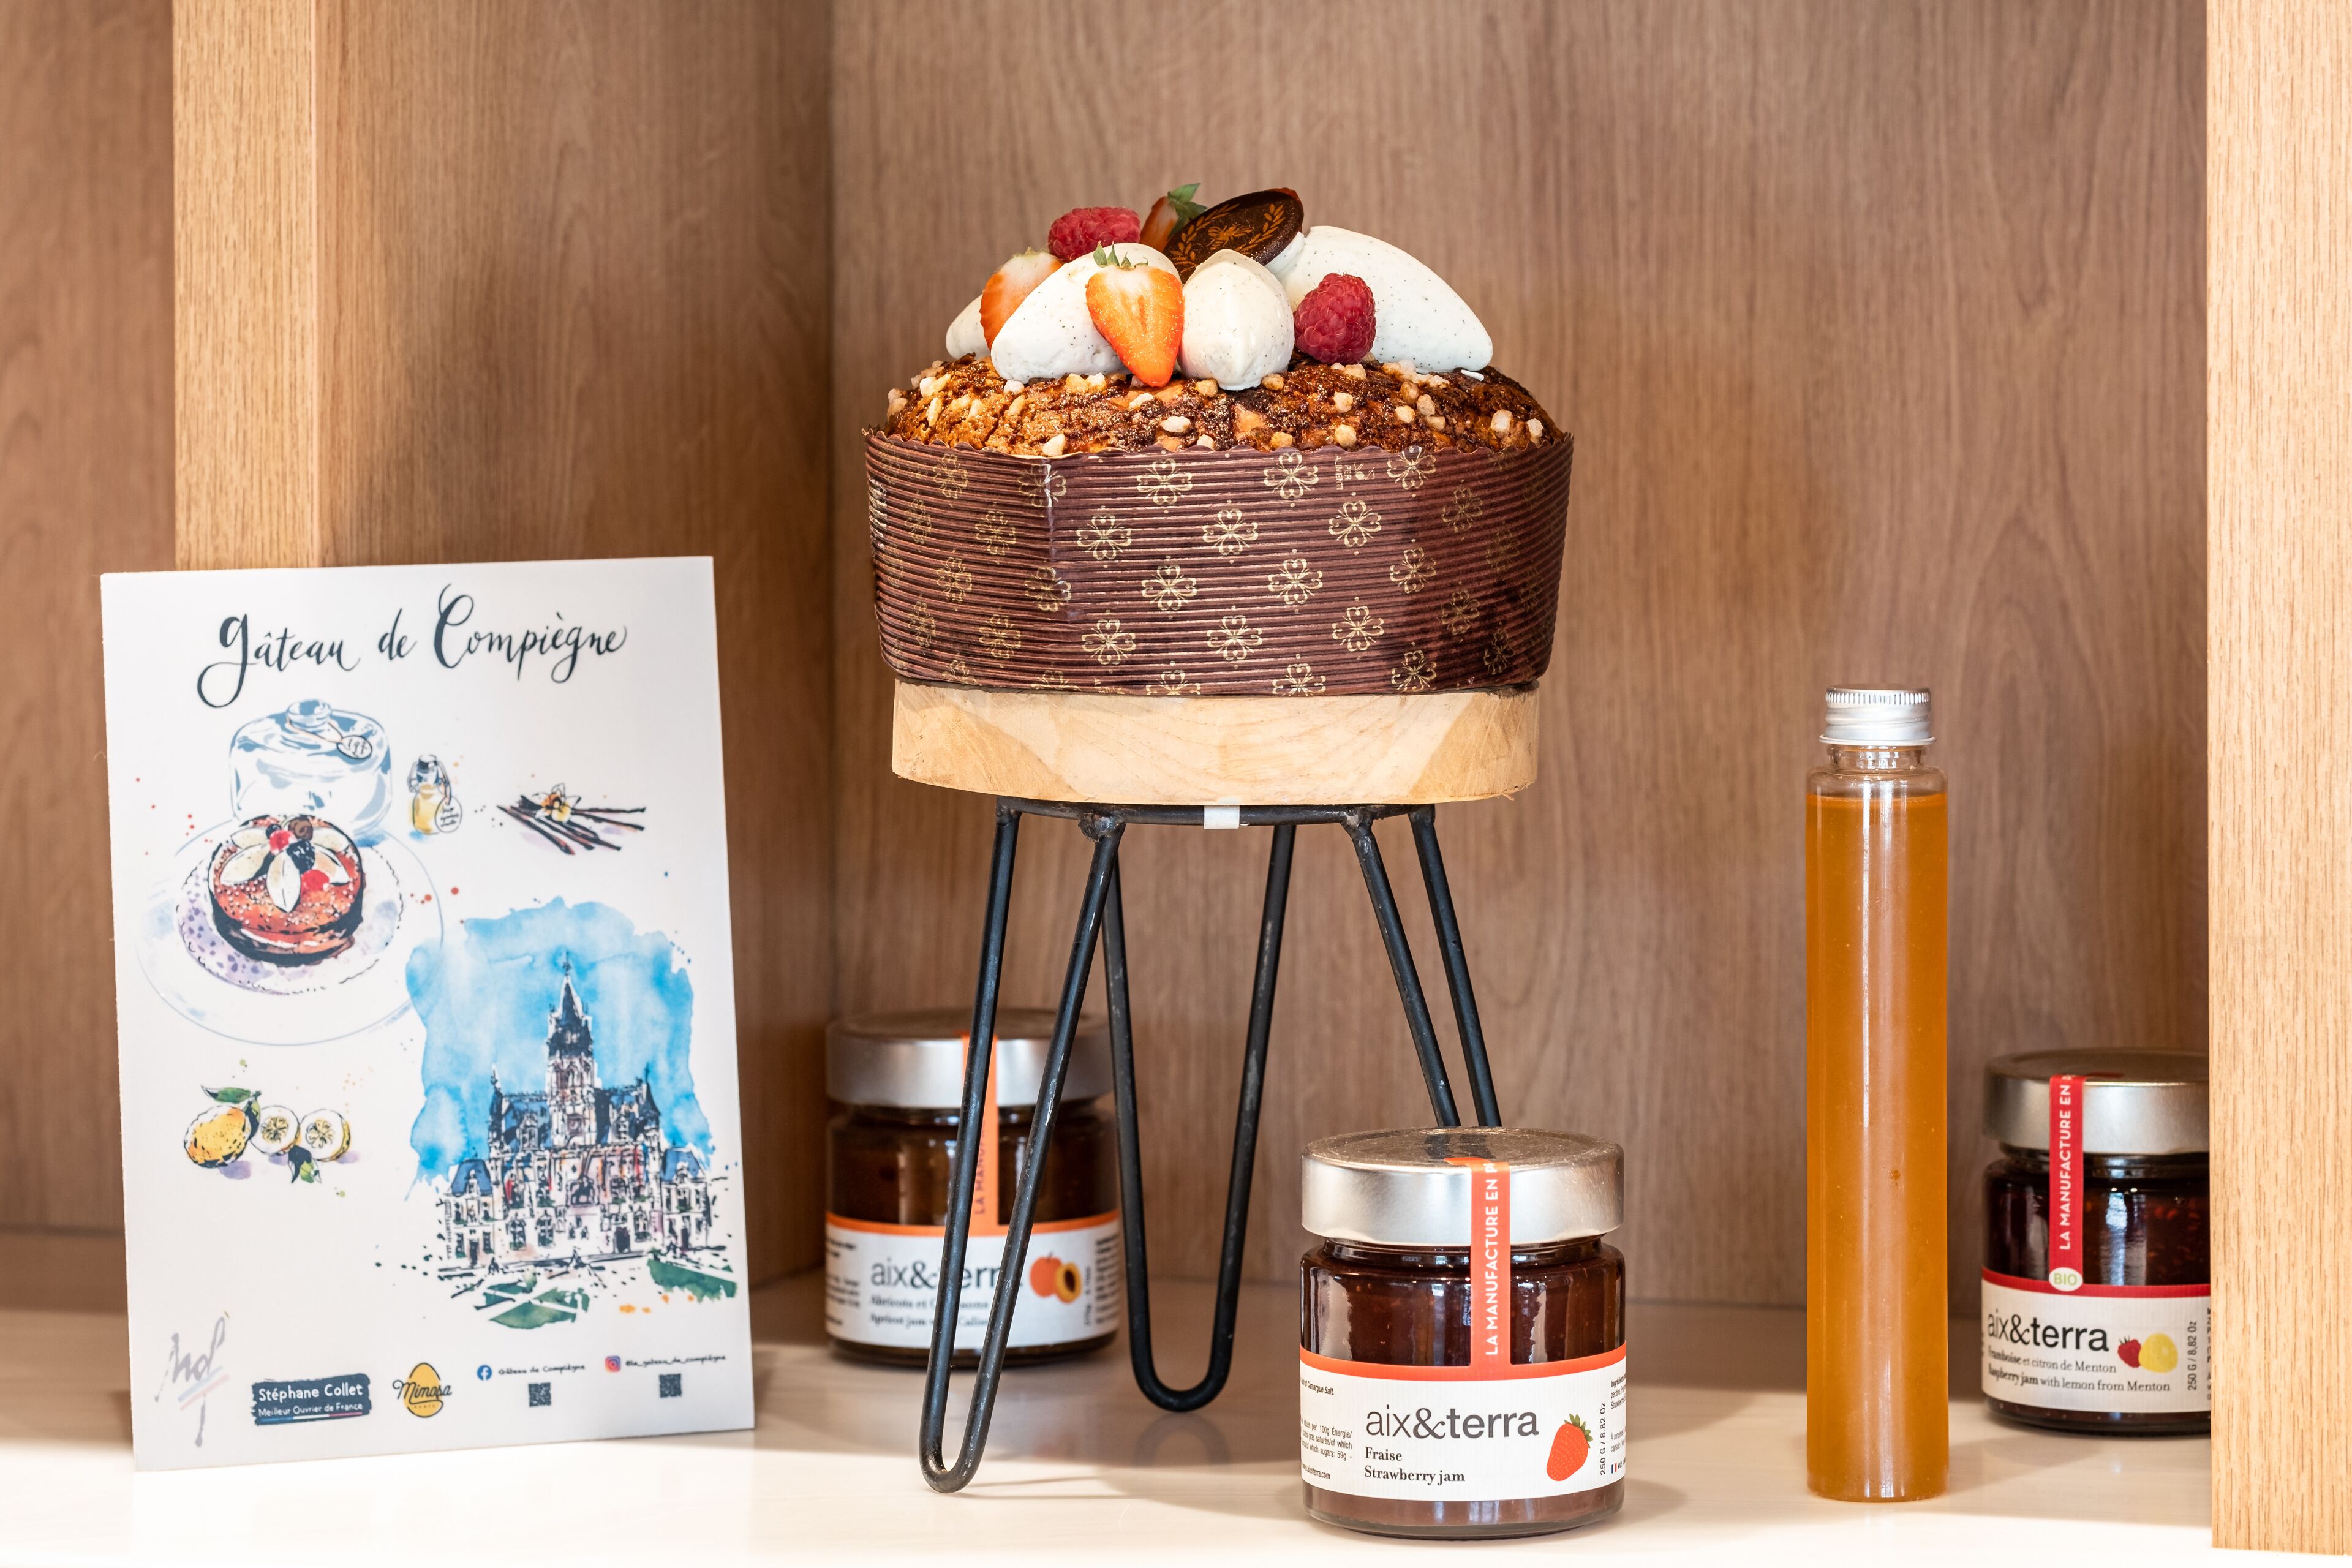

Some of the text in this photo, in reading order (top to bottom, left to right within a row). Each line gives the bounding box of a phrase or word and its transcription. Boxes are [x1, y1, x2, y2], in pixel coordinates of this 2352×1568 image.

[379, 608, 417, 661] de
[433, 582, 628, 684] Compiègne
[2060, 1084, 2070, 1105] EN
[2060, 1110, 2071, 1226] MANUFACTURE
[1485, 1179, 1498, 1200] EN
[2060, 1231, 2070, 1250] LA
[1485, 1205, 1498, 1330] MANUFACTURE
[2054, 1273, 2077, 1286] BIO
[1988, 1308, 2109, 1352] aix&terra
[2187, 1321, 2197, 1333] Oz
[1485, 1335, 1498, 1355] LA
[2022, 1357, 2030, 1366] et
[2032, 1357, 2059, 1370] citron
[2060, 1359, 2072, 1370] de
[2075, 1362, 2116, 1373] Menton
[392, 1379, 453, 1401] Mimosa
[2021, 1373, 2038, 1386] jam
[2041, 1376, 2060, 1388] with
[2062, 1378, 2095, 1390] lemon
[2097, 1379, 2124, 1391] from
[2127, 1381, 2170, 1392] Menton
[2188, 1373, 2197, 1390] 250
[258, 1382, 363, 1403] Stéphane Collet
[258, 1407, 291, 1417] Meilleur
[293, 1405, 322, 1415] Ouvrier
[336, 1402, 363, 1411] France
[1600, 1402, 1606, 1415] Oz
[1366, 1404, 1539, 1439] aix&terra
[1319, 1425, 1330, 1436] 100g
[1332, 1427, 1352, 1439] Énergie/
[1336, 1441, 1352, 1449] which
[1365, 1446, 1403, 1462] Fraise
[1337, 1450, 1347, 1461] 59g
[1365, 1465, 1465, 1486] Strawberry jam
